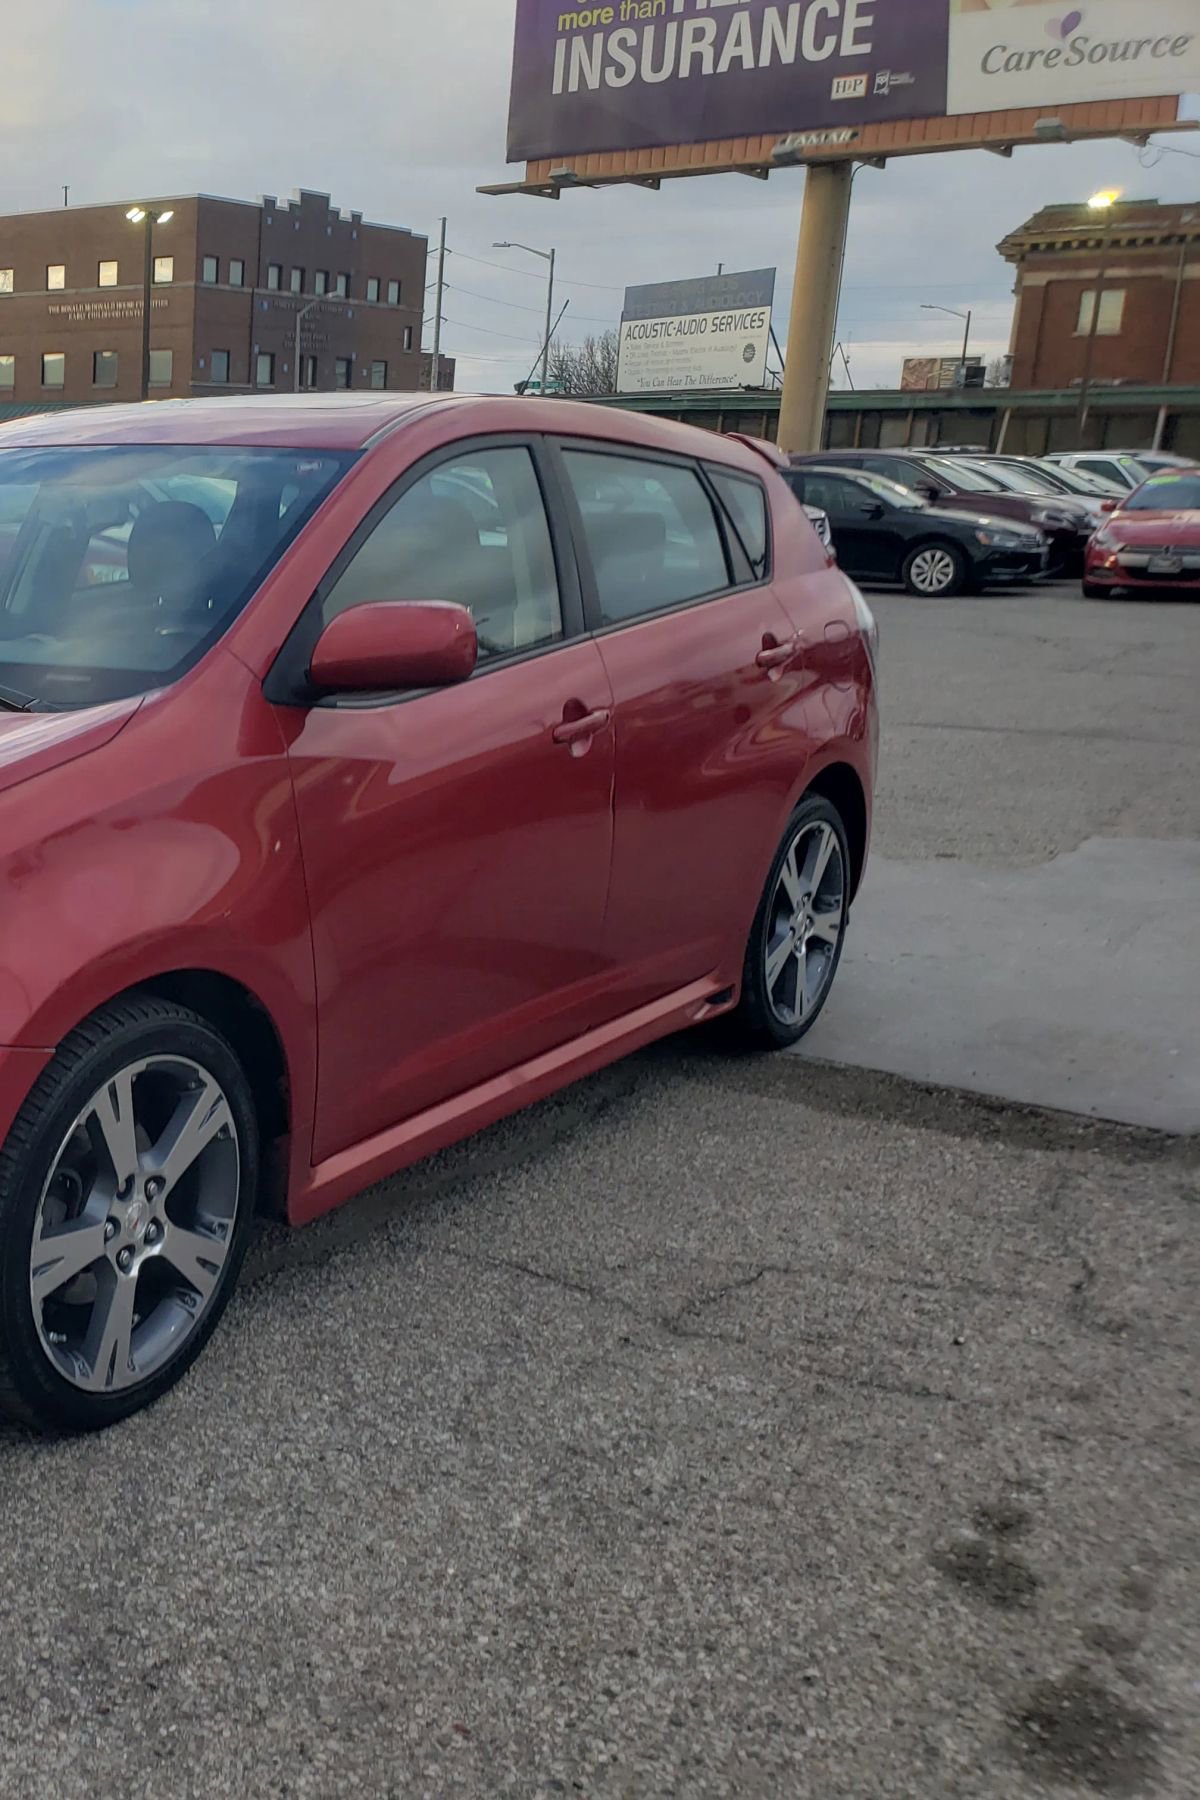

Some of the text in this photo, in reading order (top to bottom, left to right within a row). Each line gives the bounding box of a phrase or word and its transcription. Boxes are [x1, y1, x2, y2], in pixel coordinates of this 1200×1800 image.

[557, 9, 614, 31] more
[619, 0, 666, 21] than
[552, 0, 877, 95] INSURANCE
[981, 34, 1190, 75] CareSource
[711, 311, 766, 333] SERVICES
[684, 374, 697, 386] The
